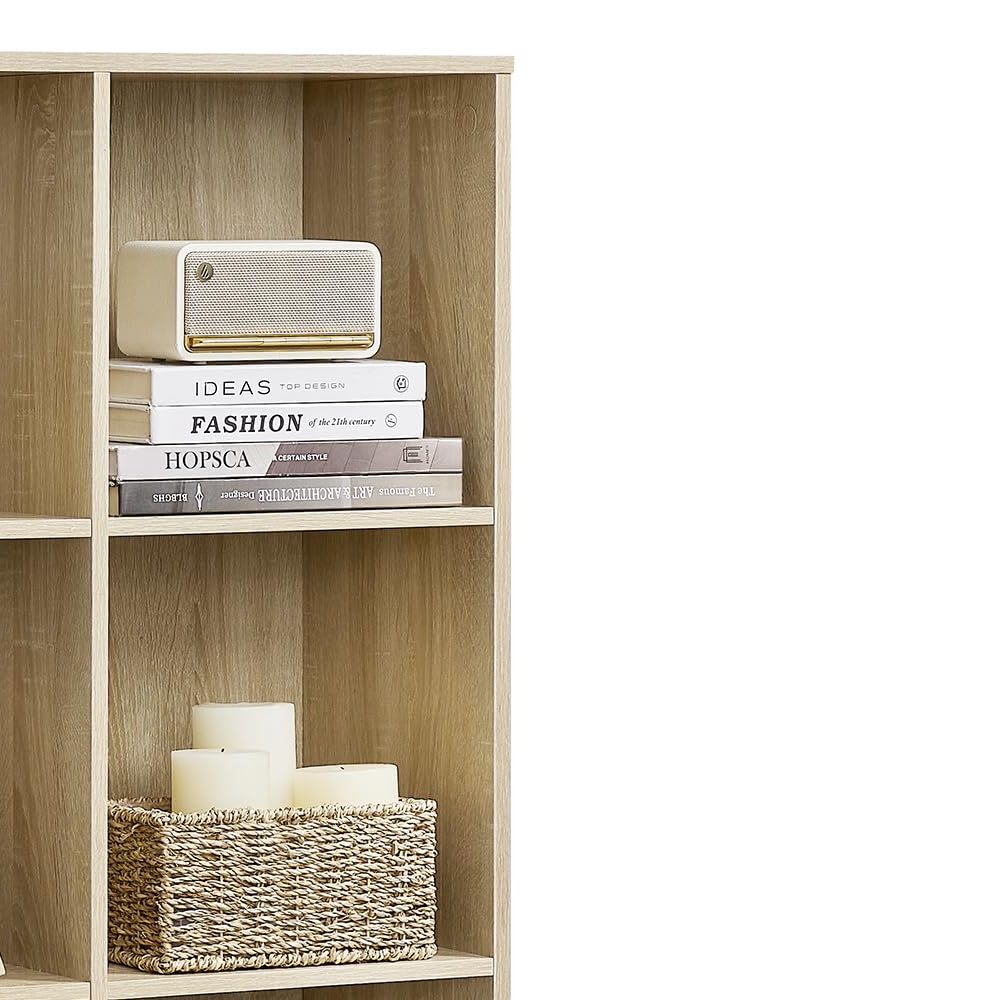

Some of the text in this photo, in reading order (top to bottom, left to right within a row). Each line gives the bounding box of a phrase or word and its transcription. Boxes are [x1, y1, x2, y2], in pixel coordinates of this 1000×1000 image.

[195, 380, 271, 396] IDEAS
[304, 382, 346, 390] DESIGN
[190, 413, 304, 434] FASHION
[308, 417, 317, 428] of
[319, 418, 331, 426] the
[331, 417, 348, 426] 21th
[349, 418, 376, 427] century
[164, 450, 252, 470] HOPSCA
[153, 493, 188, 502] BLBGHS
[220, 491, 255, 500] Designer
[257, 486, 344, 503] ARCHITECTURE
[378, 487, 416, 497] Famous
[417, 486, 436, 497] The
